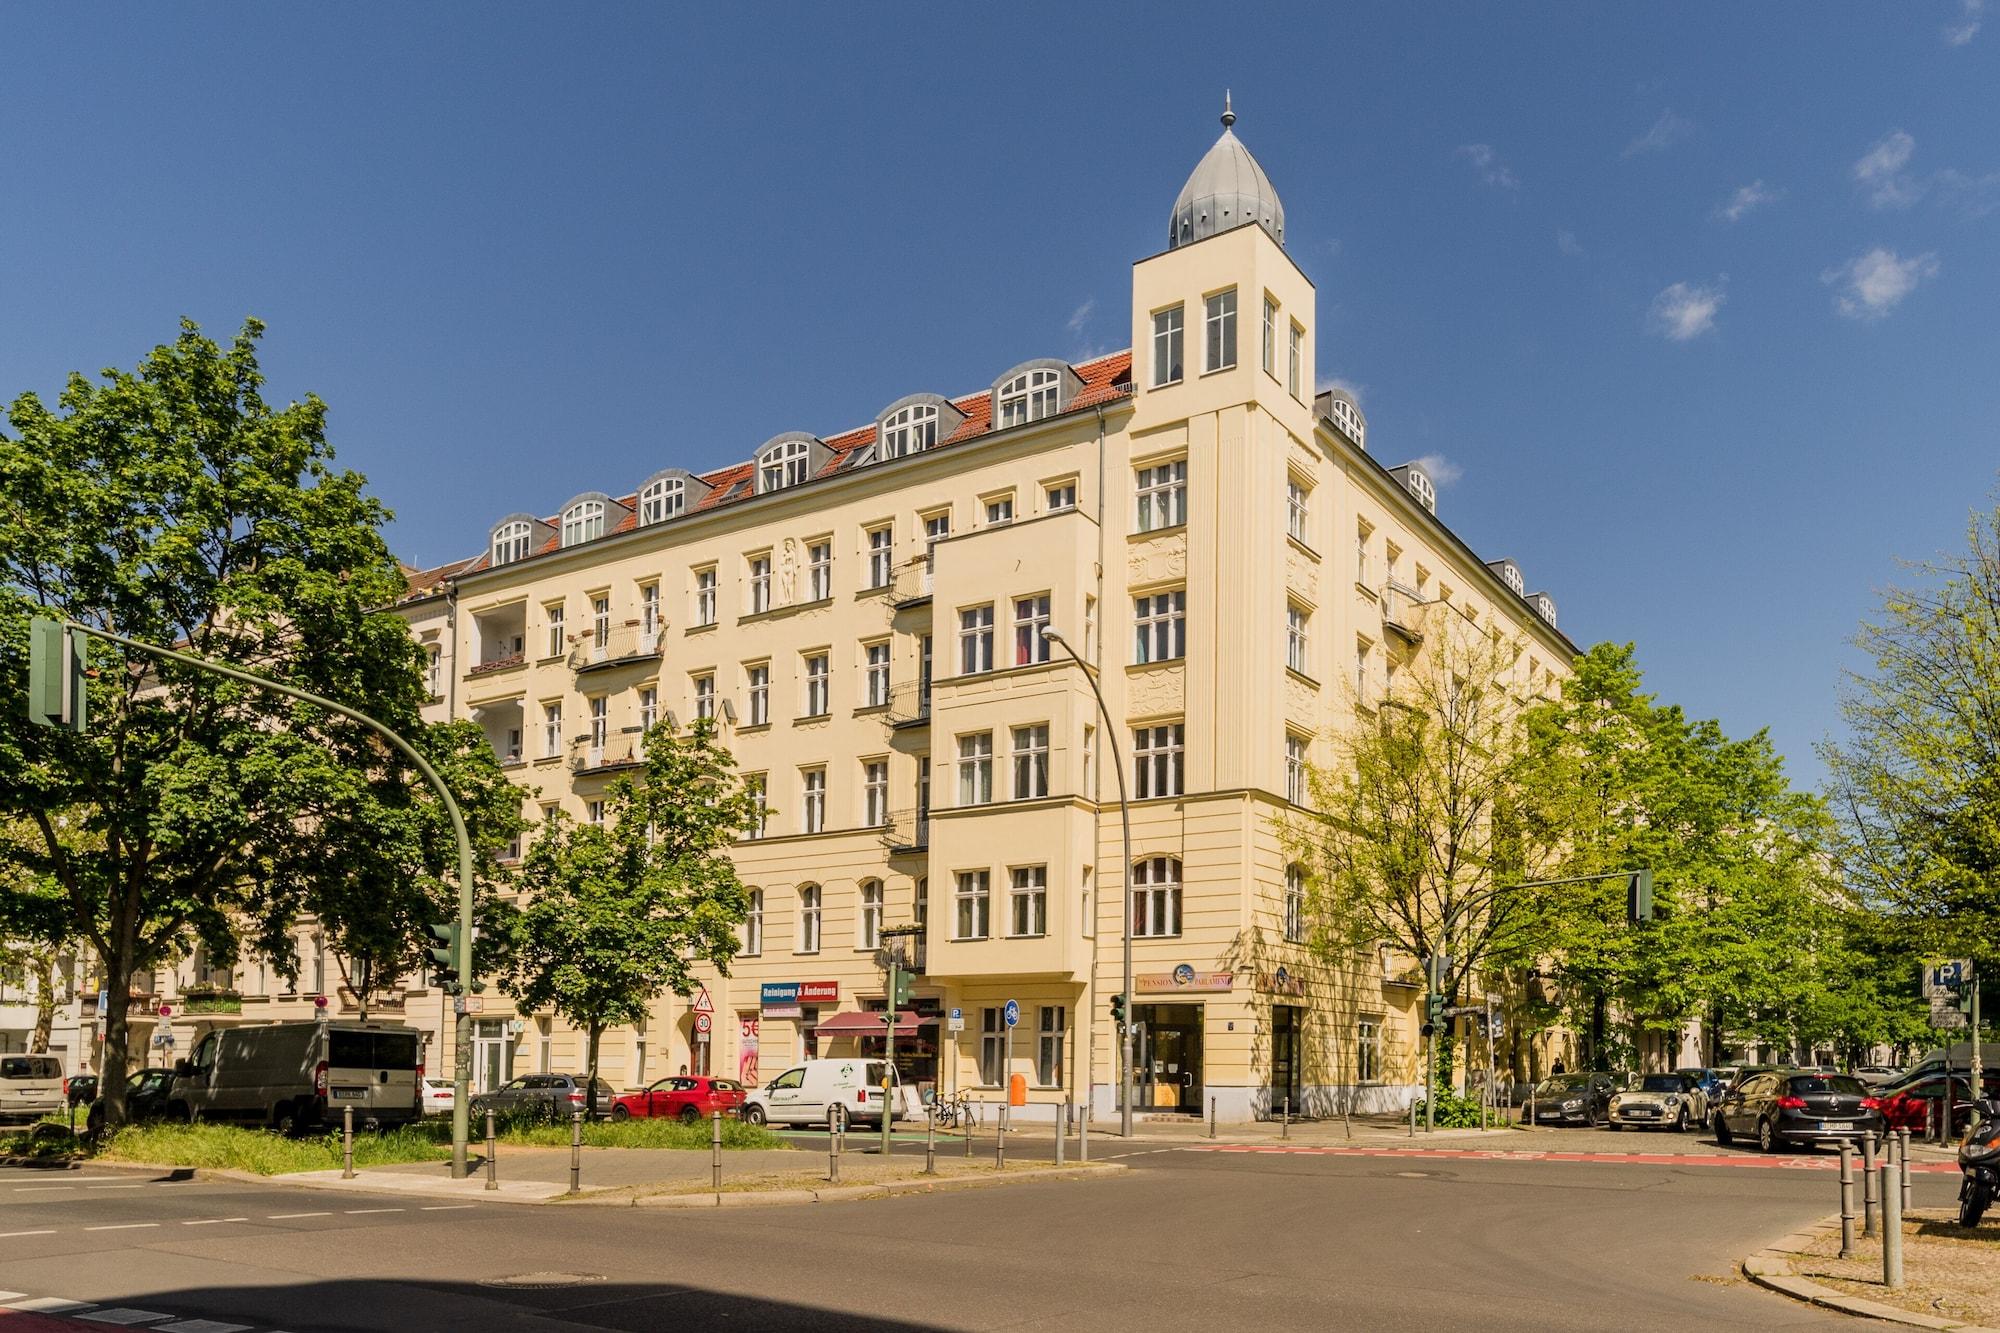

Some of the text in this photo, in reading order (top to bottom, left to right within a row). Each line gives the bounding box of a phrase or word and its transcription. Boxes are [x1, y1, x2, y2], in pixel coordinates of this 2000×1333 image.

[1940, 965, 1955, 983] P
[763, 985, 836, 998] Reinigung & Änderung
[700, 1018, 709, 1028] 30
[743, 1019, 759, 1037] 5€
